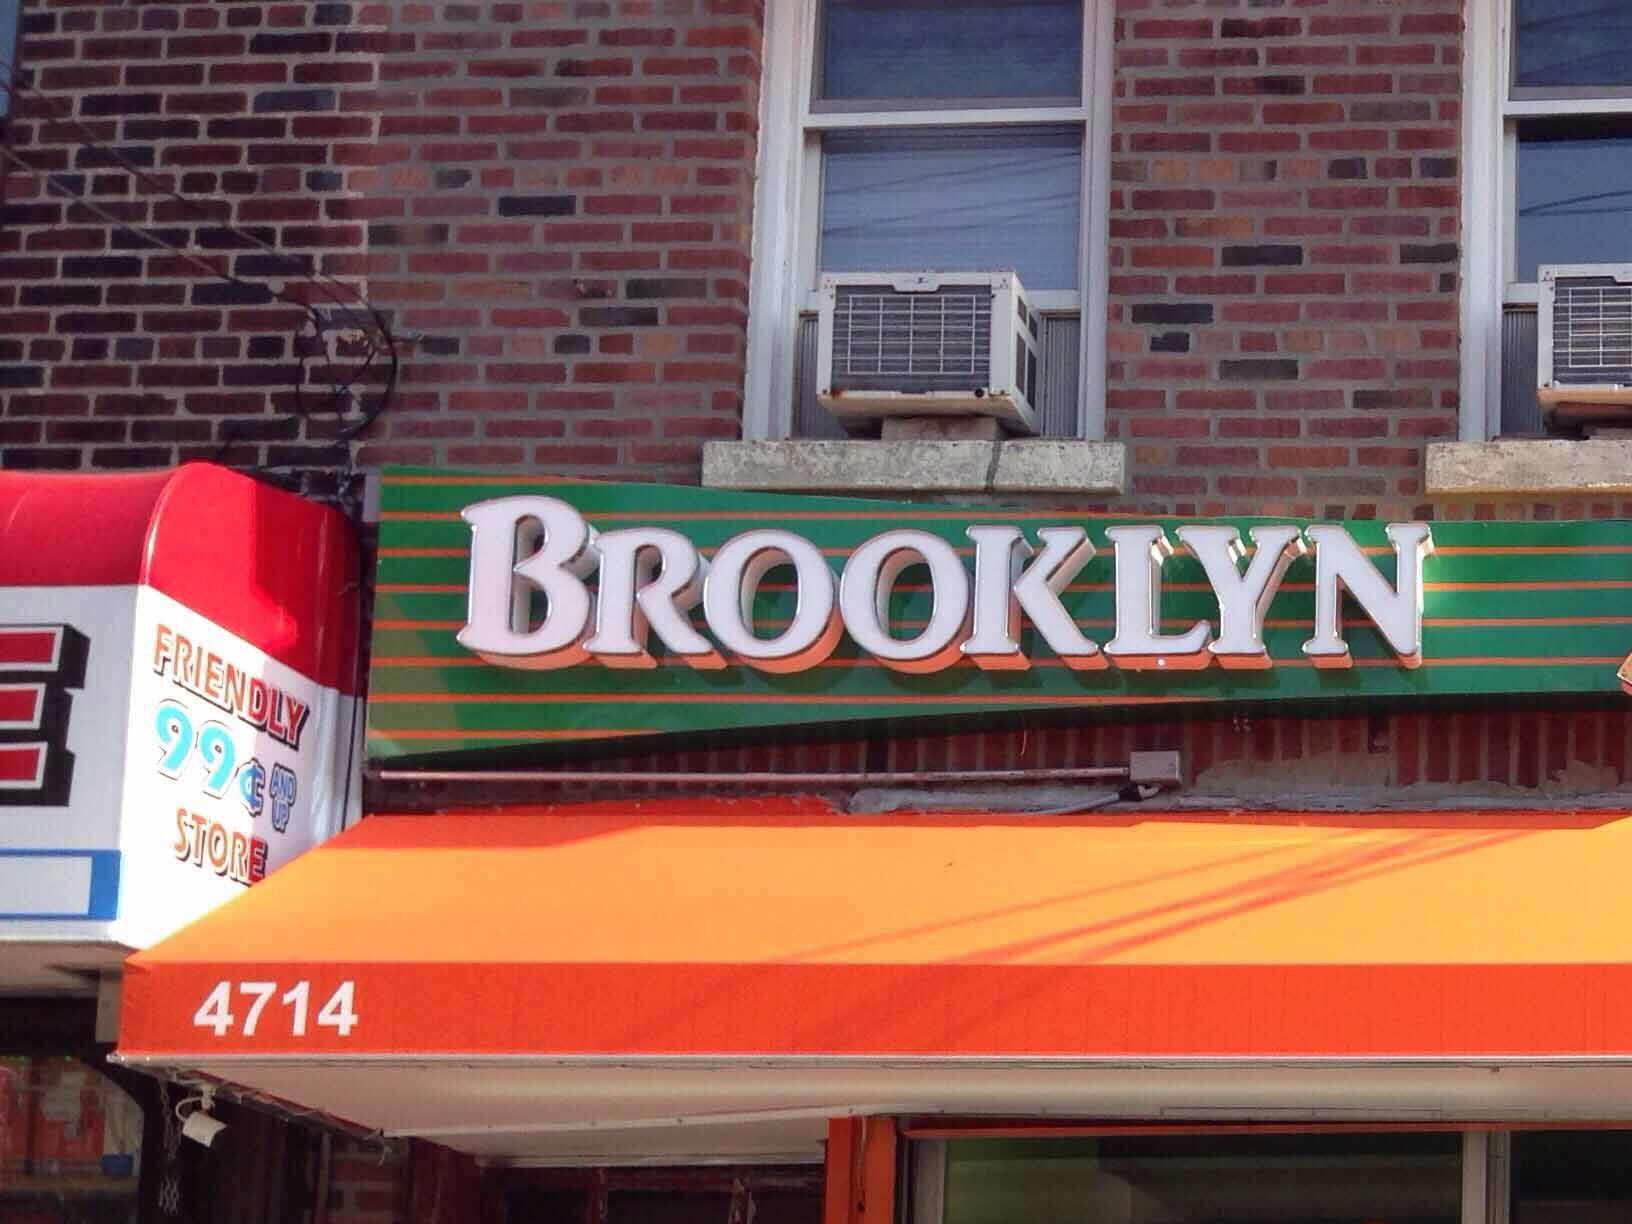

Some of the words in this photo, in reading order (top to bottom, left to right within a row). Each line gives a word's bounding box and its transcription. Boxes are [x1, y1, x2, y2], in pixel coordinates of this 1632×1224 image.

[456, 494, 1431, 668] BROOKLYN
[153, 624, 311, 752] FRIENDLY
[270, 763, 296, 802] AND
[174, 807, 268, 888] STORE
[272, 801, 294, 833] UP
[194, 981, 359, 1036] 4714
